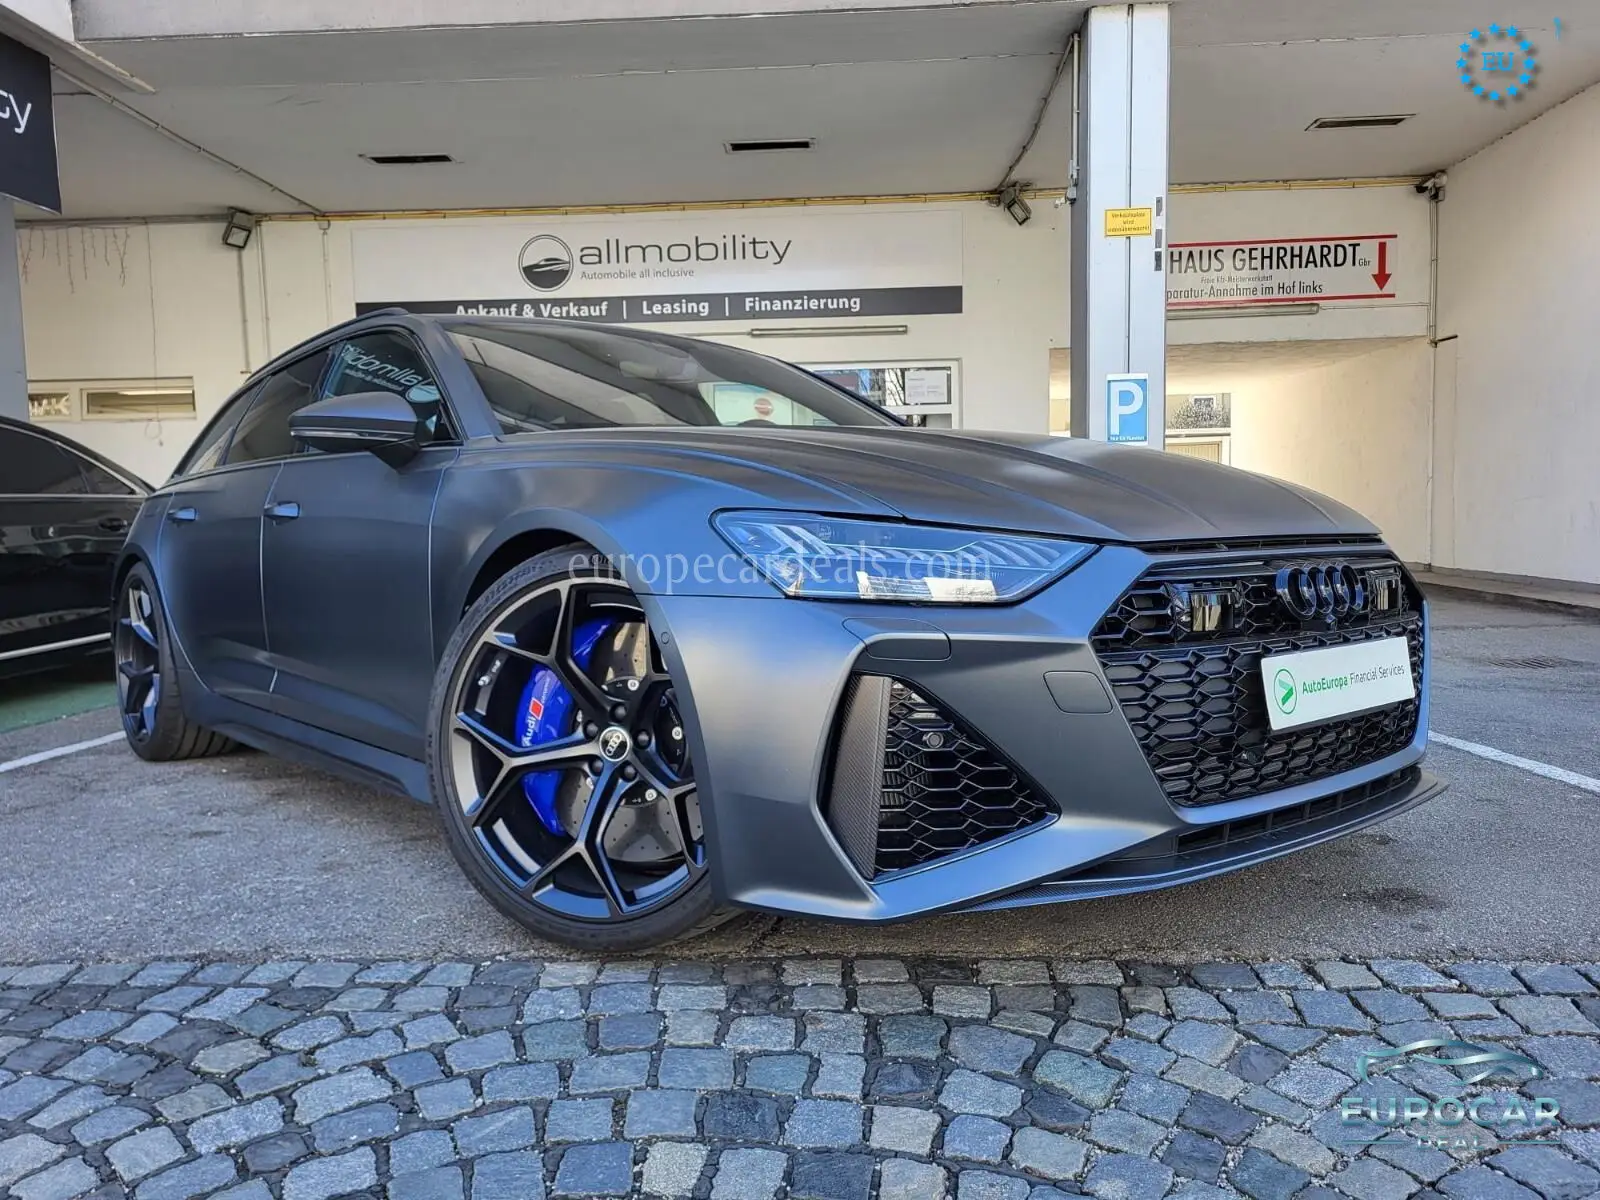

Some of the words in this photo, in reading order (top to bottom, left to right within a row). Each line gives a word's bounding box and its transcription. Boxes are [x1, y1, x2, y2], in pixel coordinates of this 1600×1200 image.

[579, 234, 792, 265] allmobility
[1169, 248, 1225, 274] HAUS
[1232, 243, 1360, 272] GEHRHARDT
[580, 269, 637, 281] Automobile
[639, 269, 650, 279] all
[653, 268, 695, 278] inclusive
[455, 304, 517, 317] Ankauf
[522, 304, 536, 317] &
[540, 301, 609, 318] Verkauf
[642, 299, 710, 316] Leasing
[744, 295, 861, 312] Finanzierung
[1166, 284, 1258, 301] paratur-Annahme
[1261, 284, 1274, 295] im
[1277, 281, 1296, 296] Hof
[1298, 281, 1323, 294] links
[1110, 382, 1143, 435] P
[1302, 675, 1348, 695] AutoEuropa
[1349, 667, 1378, 685] Financial
[1378, 663, 1405, 679] Services
[521, 715, 537, 748] Audi
